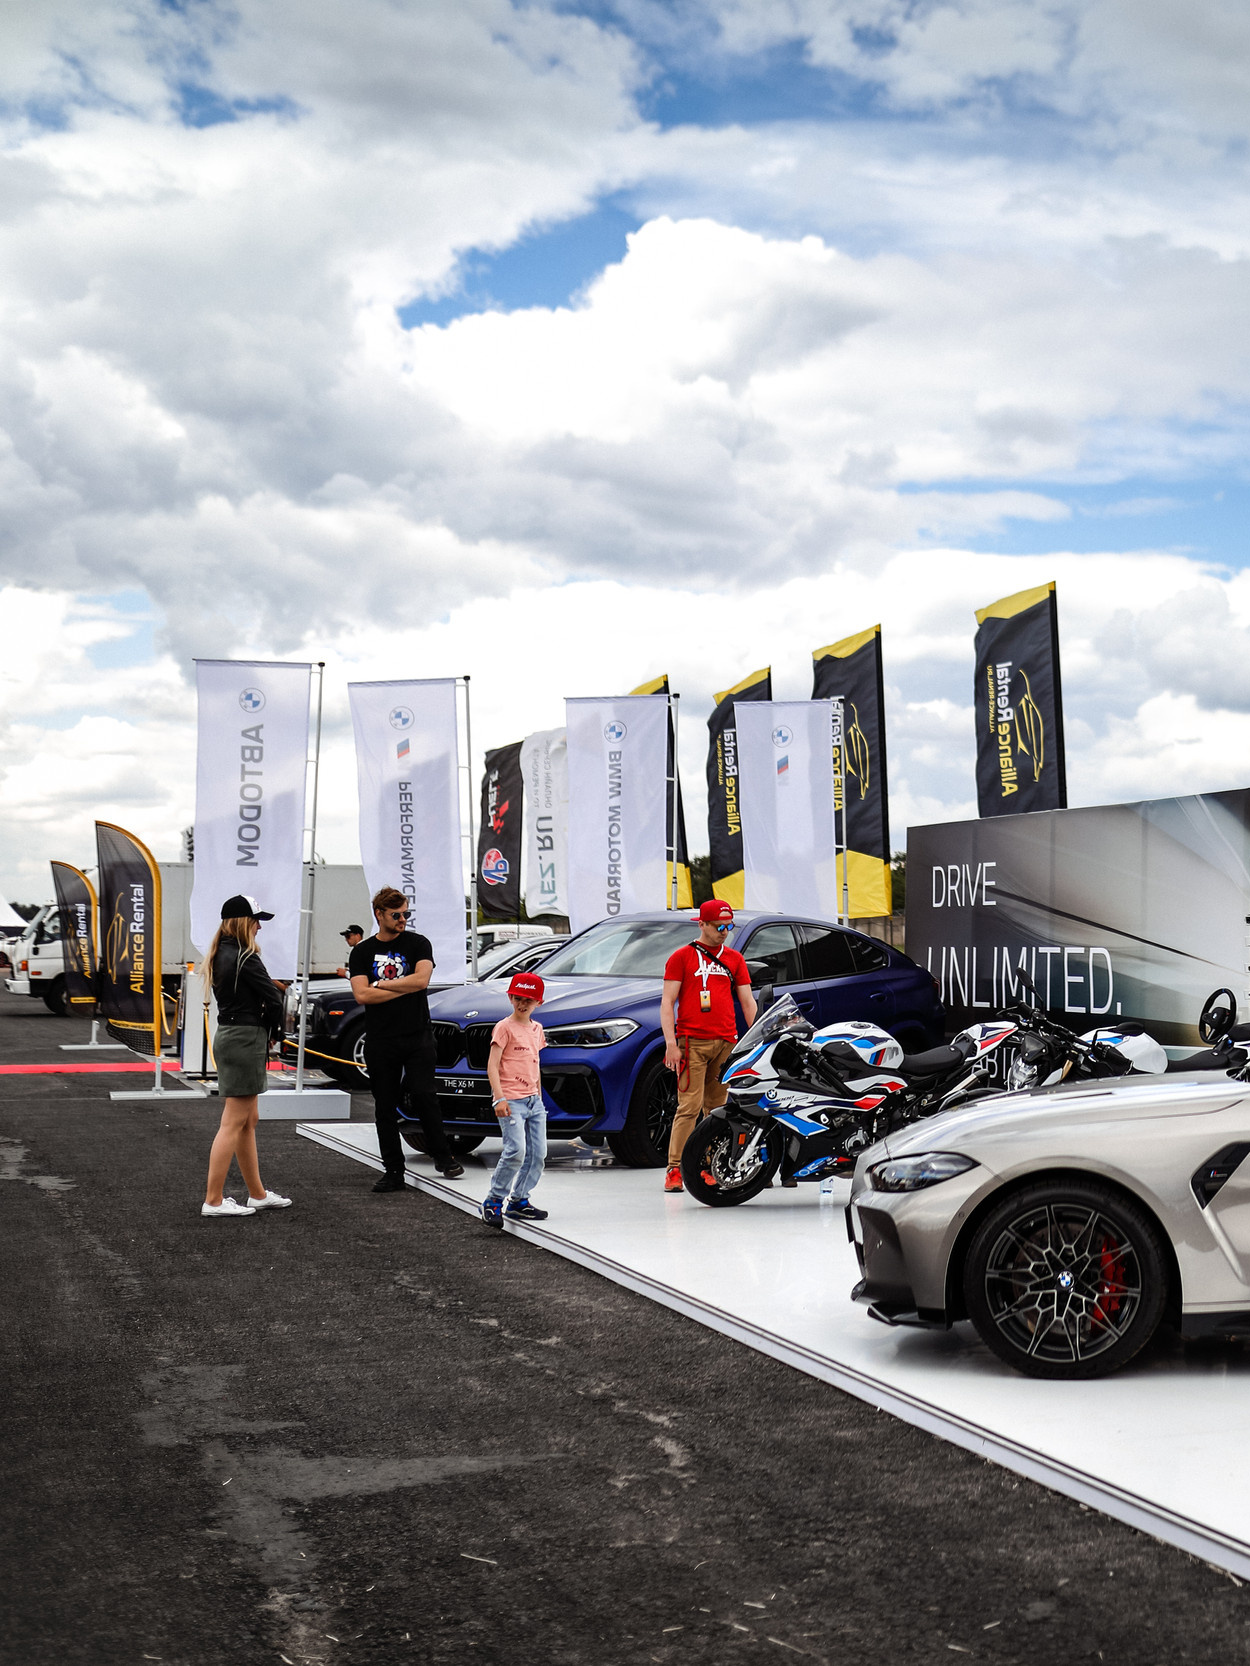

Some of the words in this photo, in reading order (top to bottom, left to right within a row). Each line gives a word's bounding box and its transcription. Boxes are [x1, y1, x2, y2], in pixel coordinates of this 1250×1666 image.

[932, 861, 997, 908] DRIVE
[75, 903, 92, 979] AllianceRental
[129, 883, 145, 994] AllianceRental
[927, 946, 1122, 1016] UNLIMITED.
[443, 1079, 458, 1088] THE
[458, 1080, 467, 1088] X6
[468, 1080, 475, 1088] M
